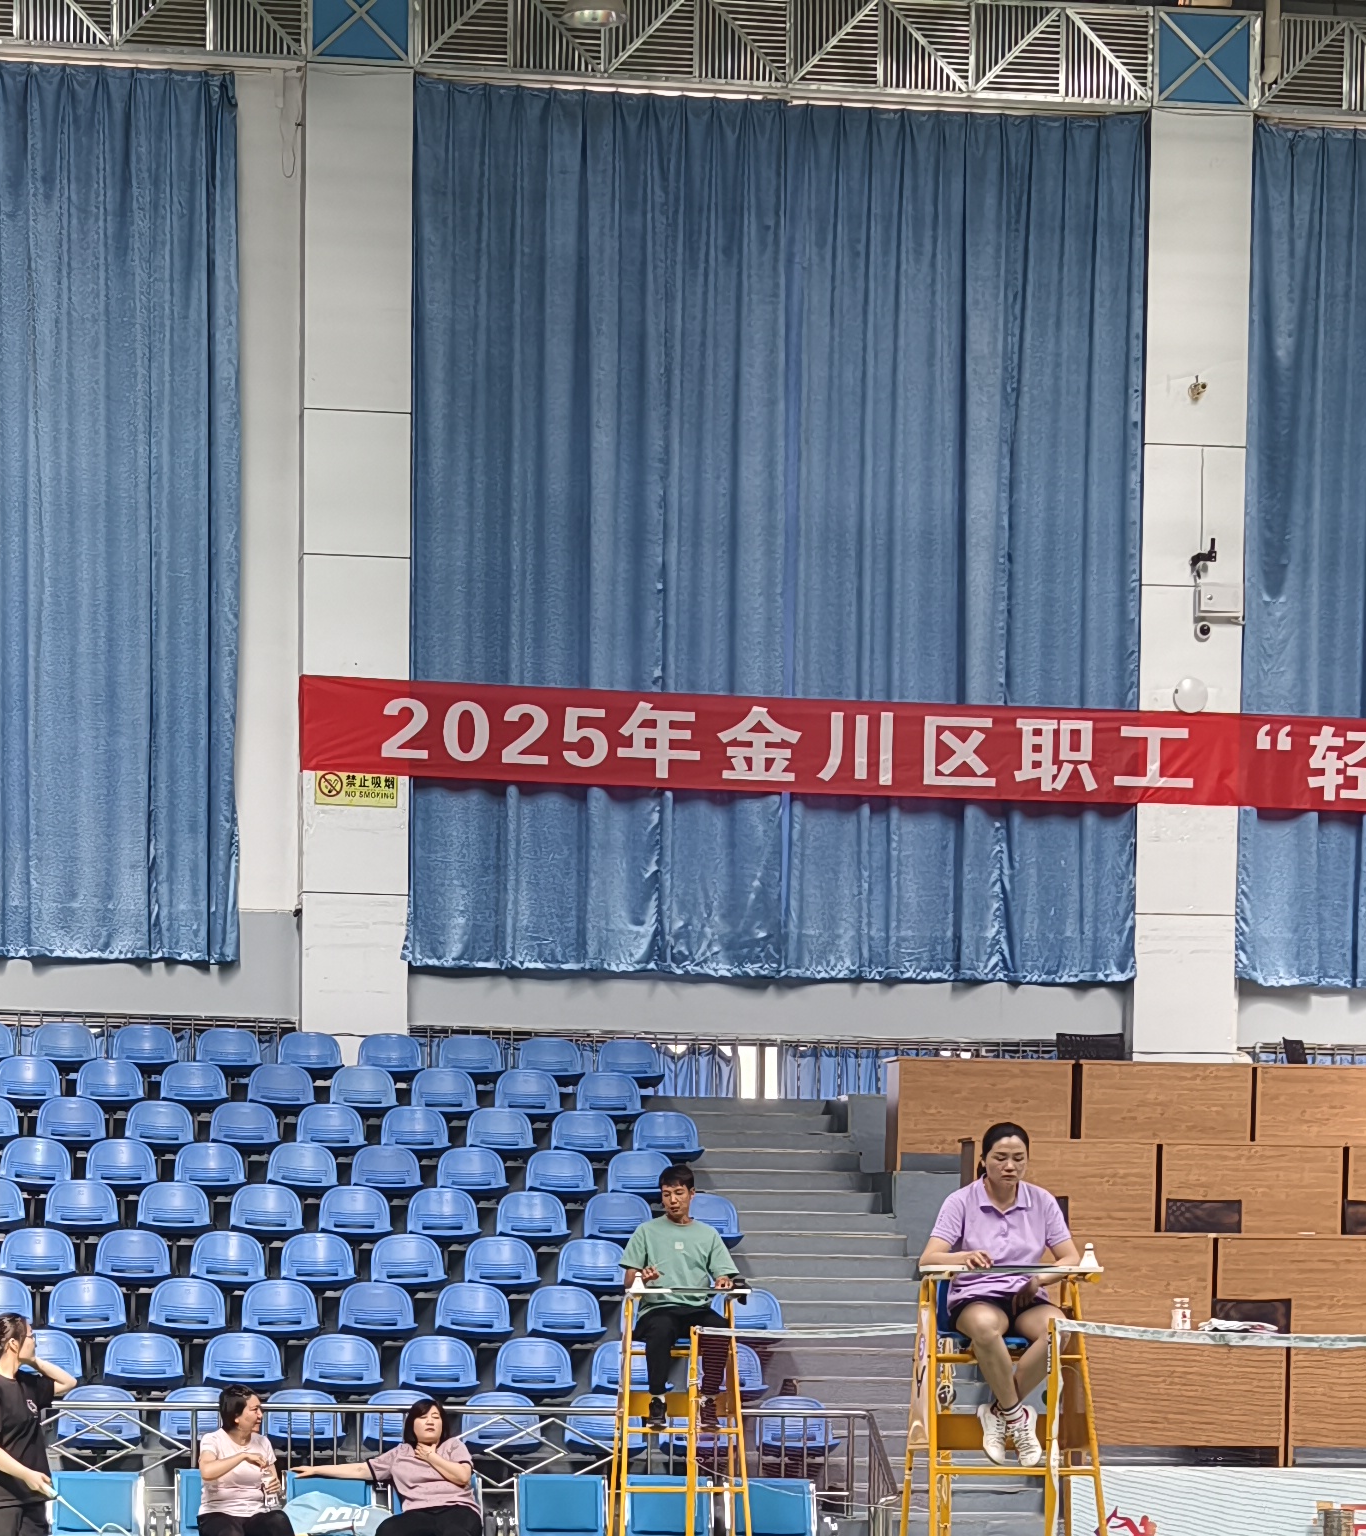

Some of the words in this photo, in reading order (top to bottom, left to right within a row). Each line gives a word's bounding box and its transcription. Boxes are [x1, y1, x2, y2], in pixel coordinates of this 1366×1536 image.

[345, 774, 395, 790] 禁止吸烟
[359, 791, 395, 800] SMOKING
